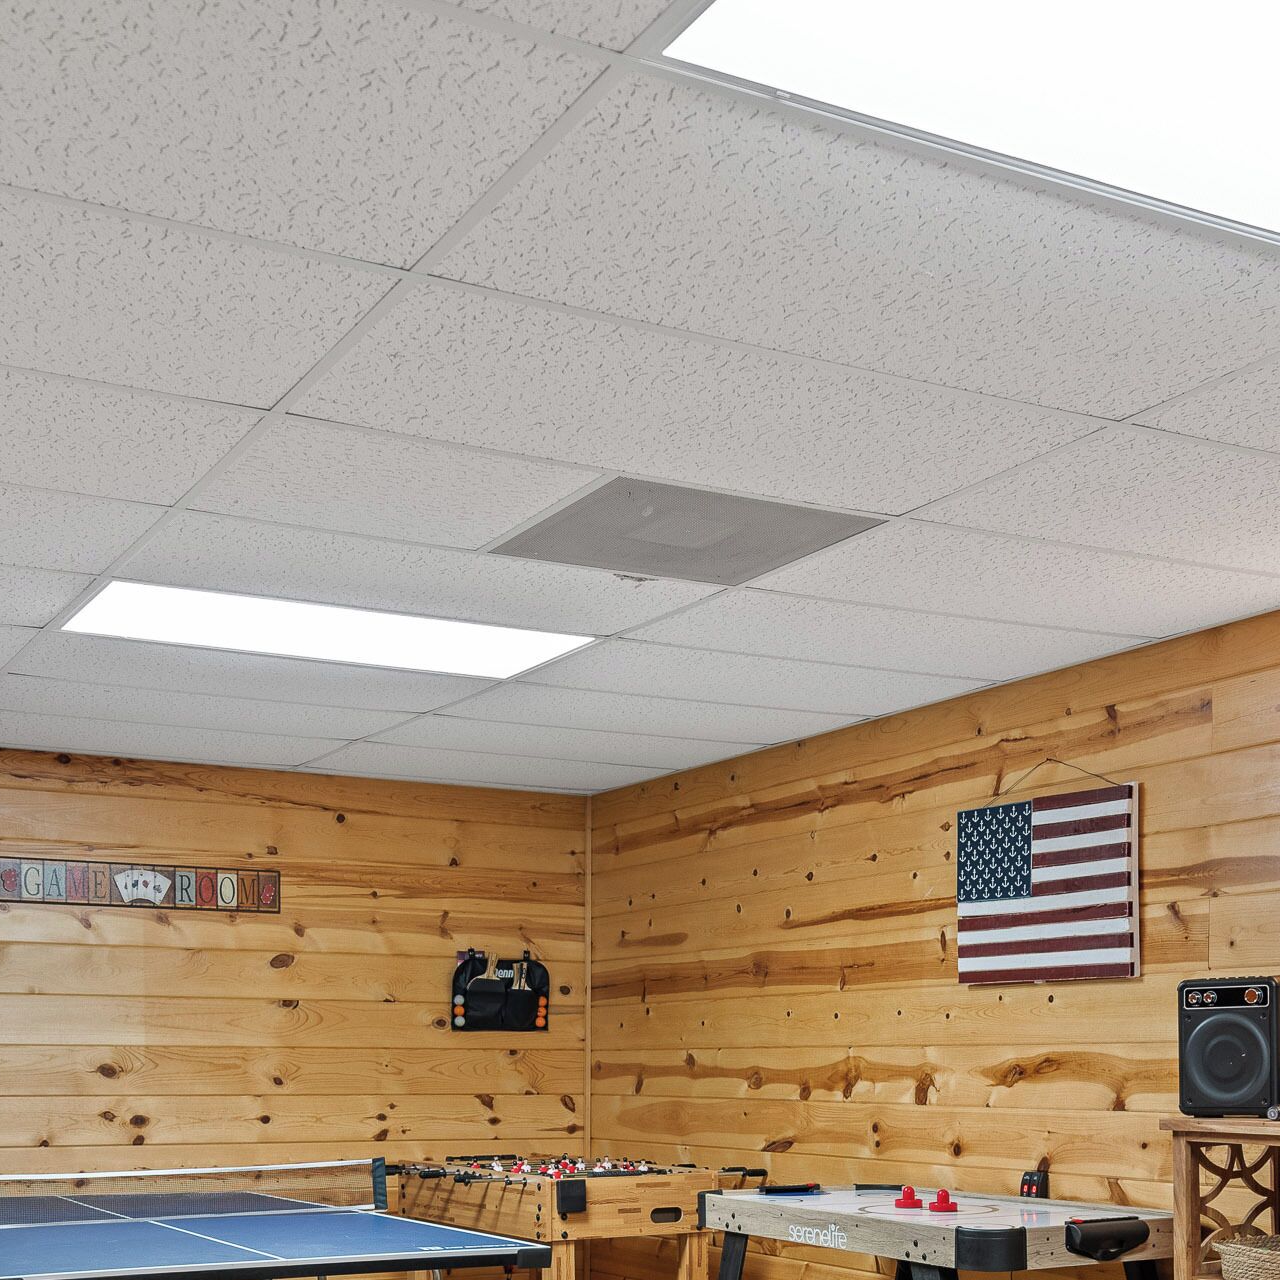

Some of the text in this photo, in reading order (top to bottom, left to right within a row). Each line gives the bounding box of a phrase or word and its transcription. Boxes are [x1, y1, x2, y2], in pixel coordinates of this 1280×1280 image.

[23, 866, 257, 905] GAME ROOM
[788, 1222, 847, 1249] serenelife
